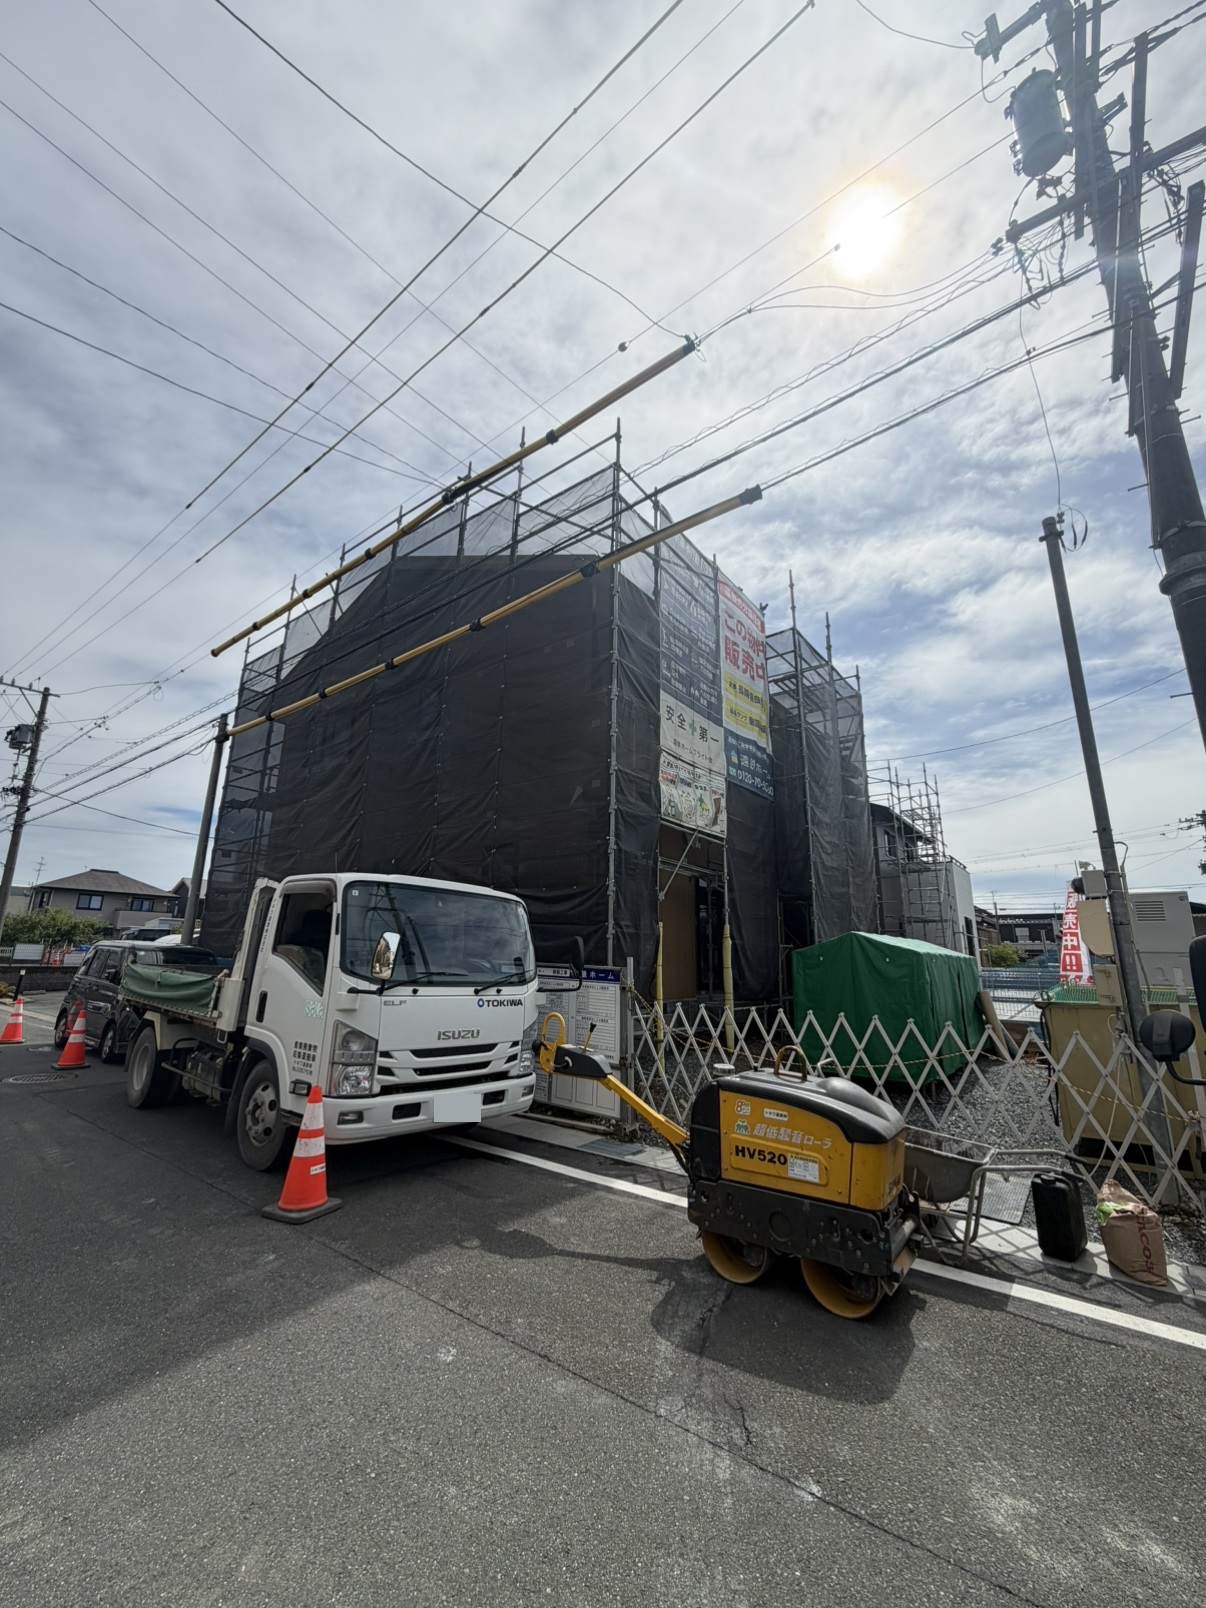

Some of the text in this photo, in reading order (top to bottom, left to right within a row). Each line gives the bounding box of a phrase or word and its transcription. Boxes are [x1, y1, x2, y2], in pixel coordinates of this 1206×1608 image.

[724, 609, 765, 658] この物件
[724, 635, 765, 682] 販売中
[666, 705, 720, 743] 安全 第一
[486, 998, 524, 1008] TOKIWA
[437, 1028, 481, 1041] ISUZU
[735, 1144, 788, 1167] HV520
